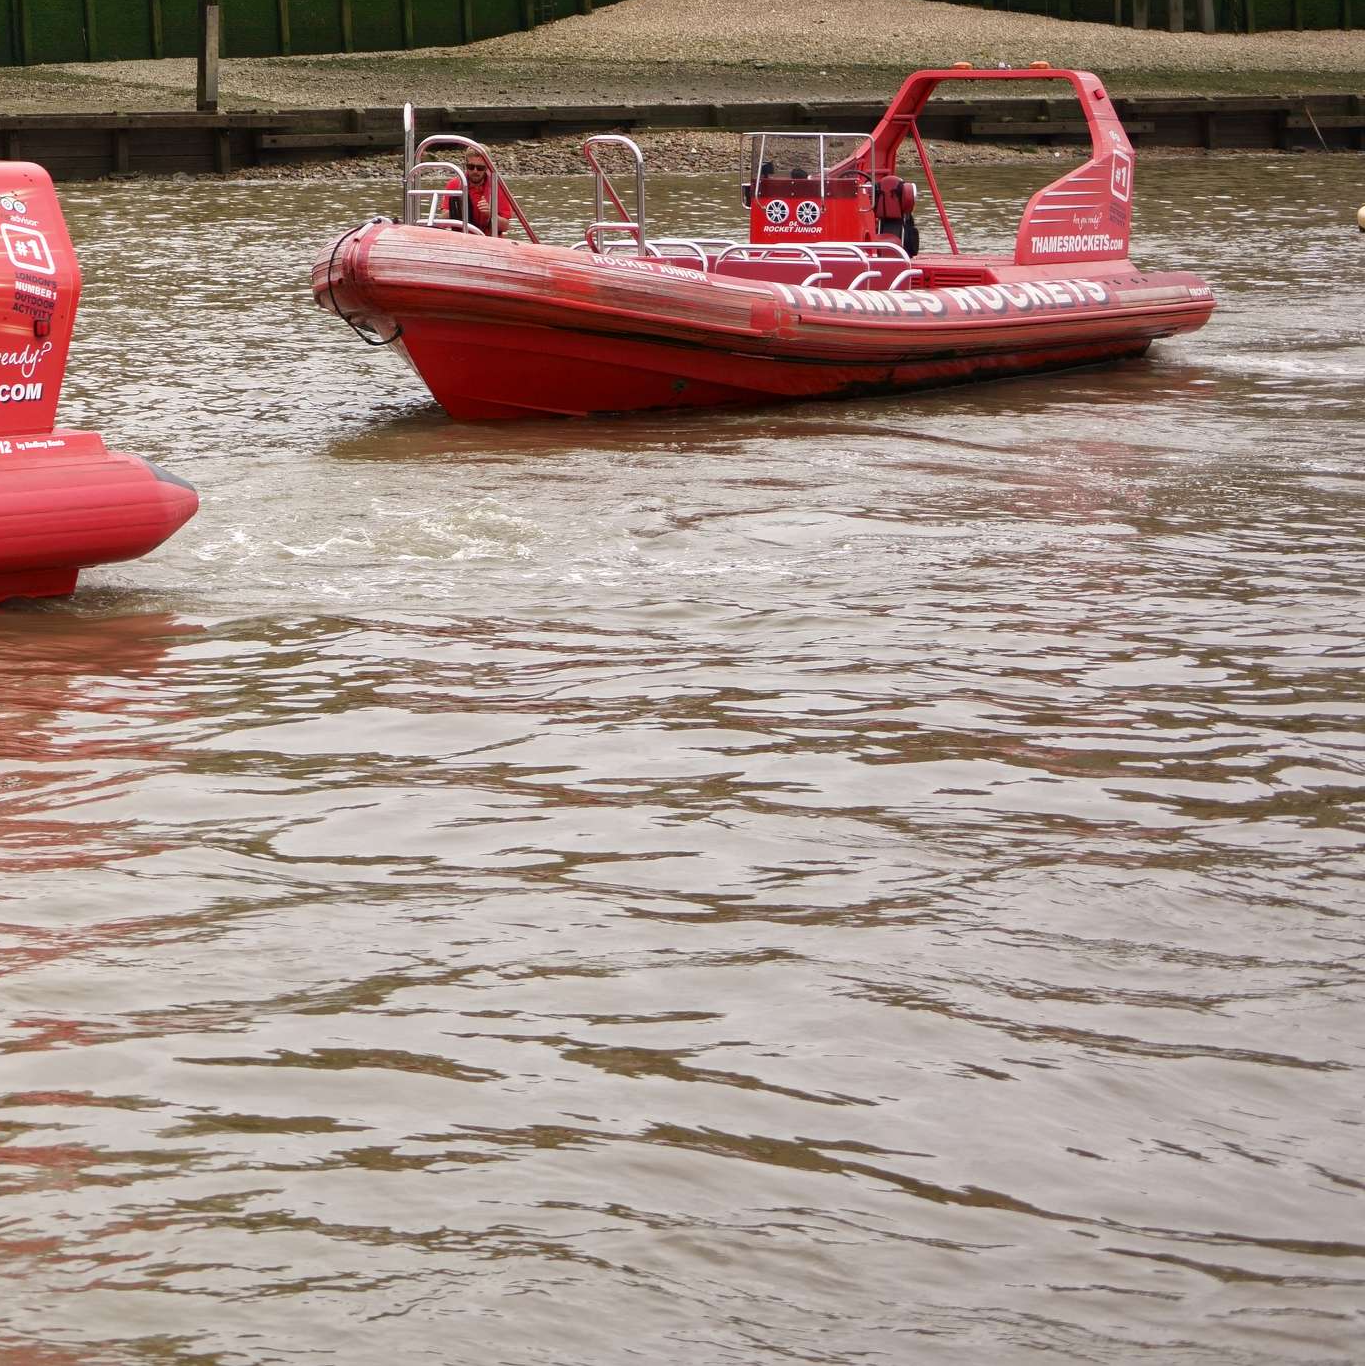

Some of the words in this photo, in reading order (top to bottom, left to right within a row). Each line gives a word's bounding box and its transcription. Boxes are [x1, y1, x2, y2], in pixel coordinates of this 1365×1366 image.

[1115, 166, 1127, 187] #1
[794, 226, 823, 234] JUNIOR
[15, 239, 42, 261] #1
[592, 255, 655, 271] ROCKET
[659, 265, 708, 282] JUNIOR
[15, 273, 57, 289] LONDON'S
[15, 281, 52, 299] NUMBER
[51, 292, 57, 301] 1
[15, 292, 55, 310] OUTDOOR
[773, 281, 944, 313] THAMES
[941, 278, 1108, 311] ROCKETS
[13, 302, 53, 321] ACTIVITY
